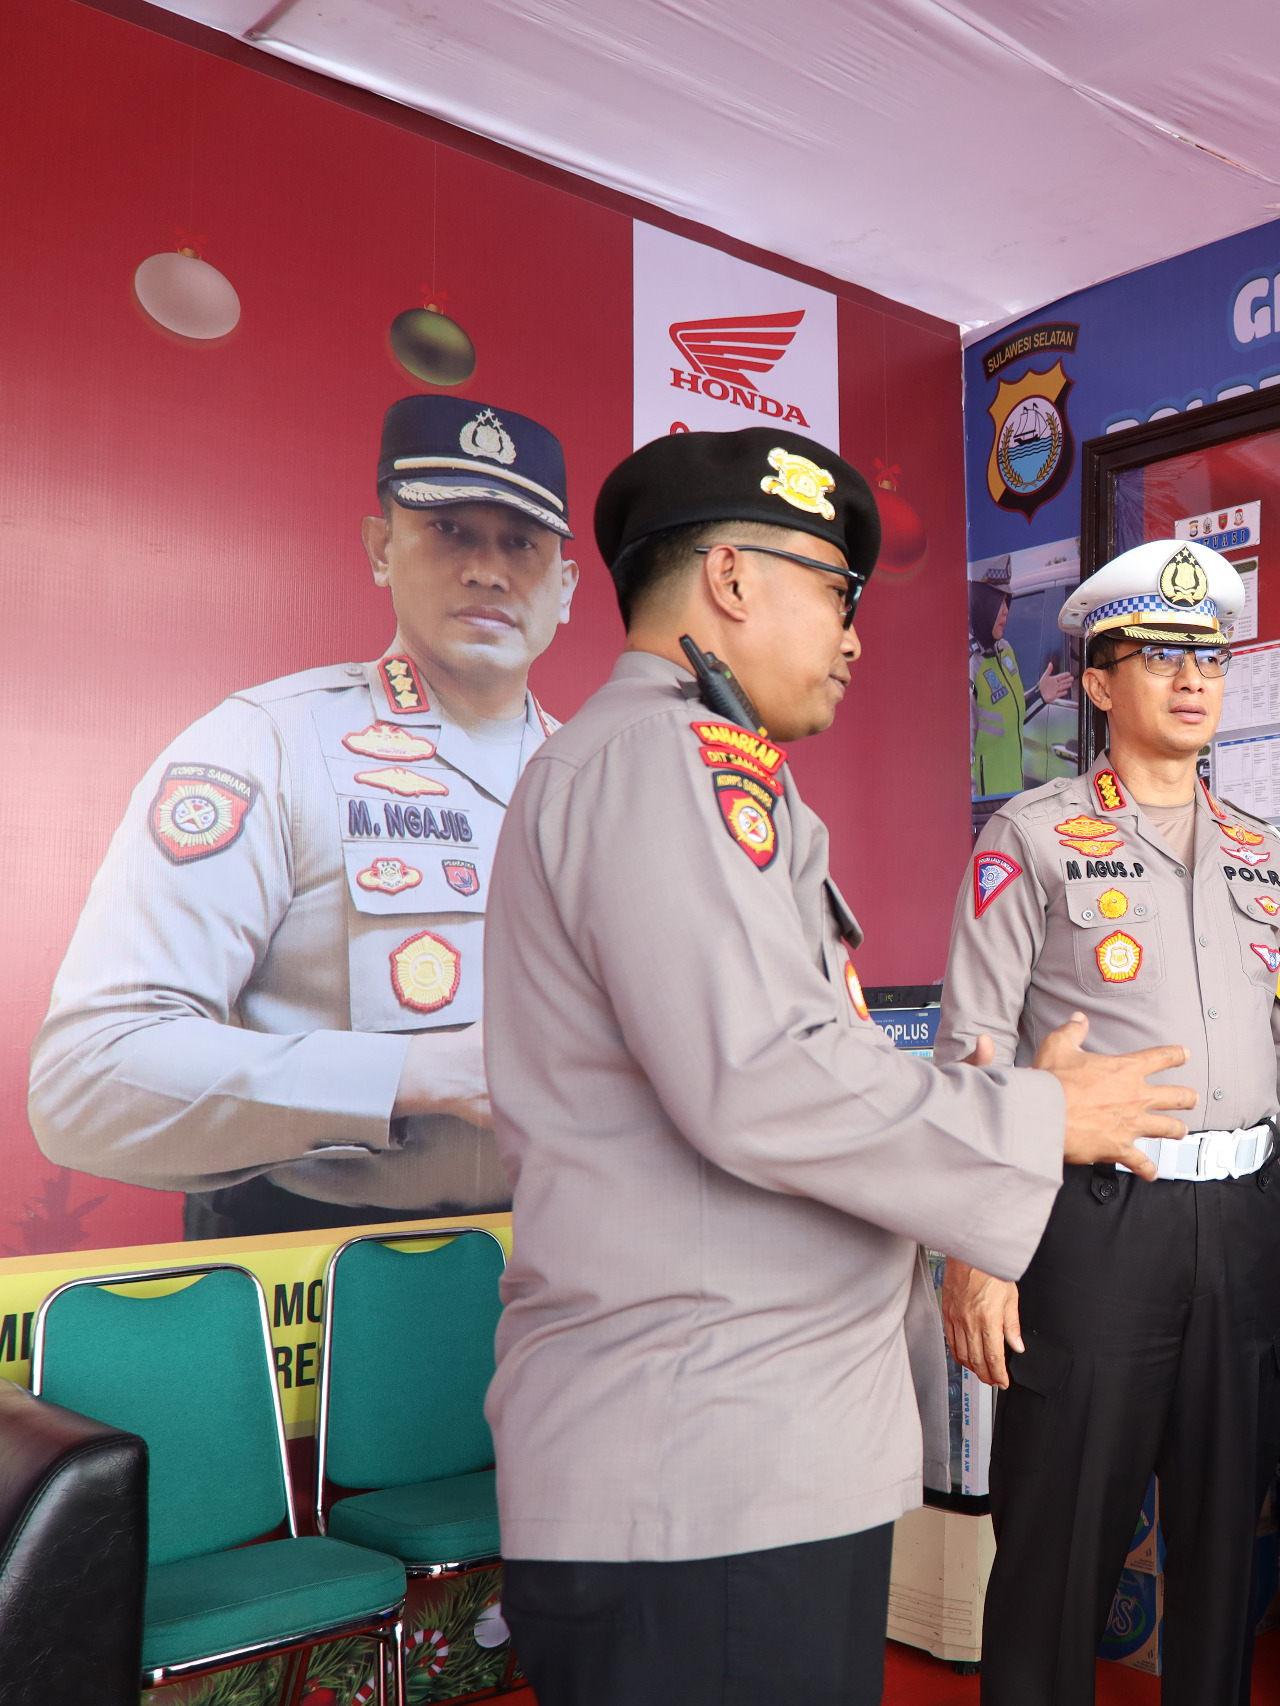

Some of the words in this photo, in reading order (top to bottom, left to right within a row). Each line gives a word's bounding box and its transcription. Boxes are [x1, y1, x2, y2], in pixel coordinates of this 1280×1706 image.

[987, 336, 1032, 373] SULAWESI
[1033, 331, 1073, 347] SELATAN
[670, 368, 810, 428] HONDA
[699, 726, 779, 769] BAHARKAM
[707, 751, 727, 763] DIT
[170, 766, 205, 777] KORPS
[207, 769, 252, 798] SABHARA
[348, 799, 382, 836] M.
[384, 803, 474, 843] NGAJIB
[1066, 862, 1082, 881] M
[1086, 860, 1145, 880] AGUS.P
[964, 1413, 971, 1426] MY
[965, 1459, 971, 1472] MY
